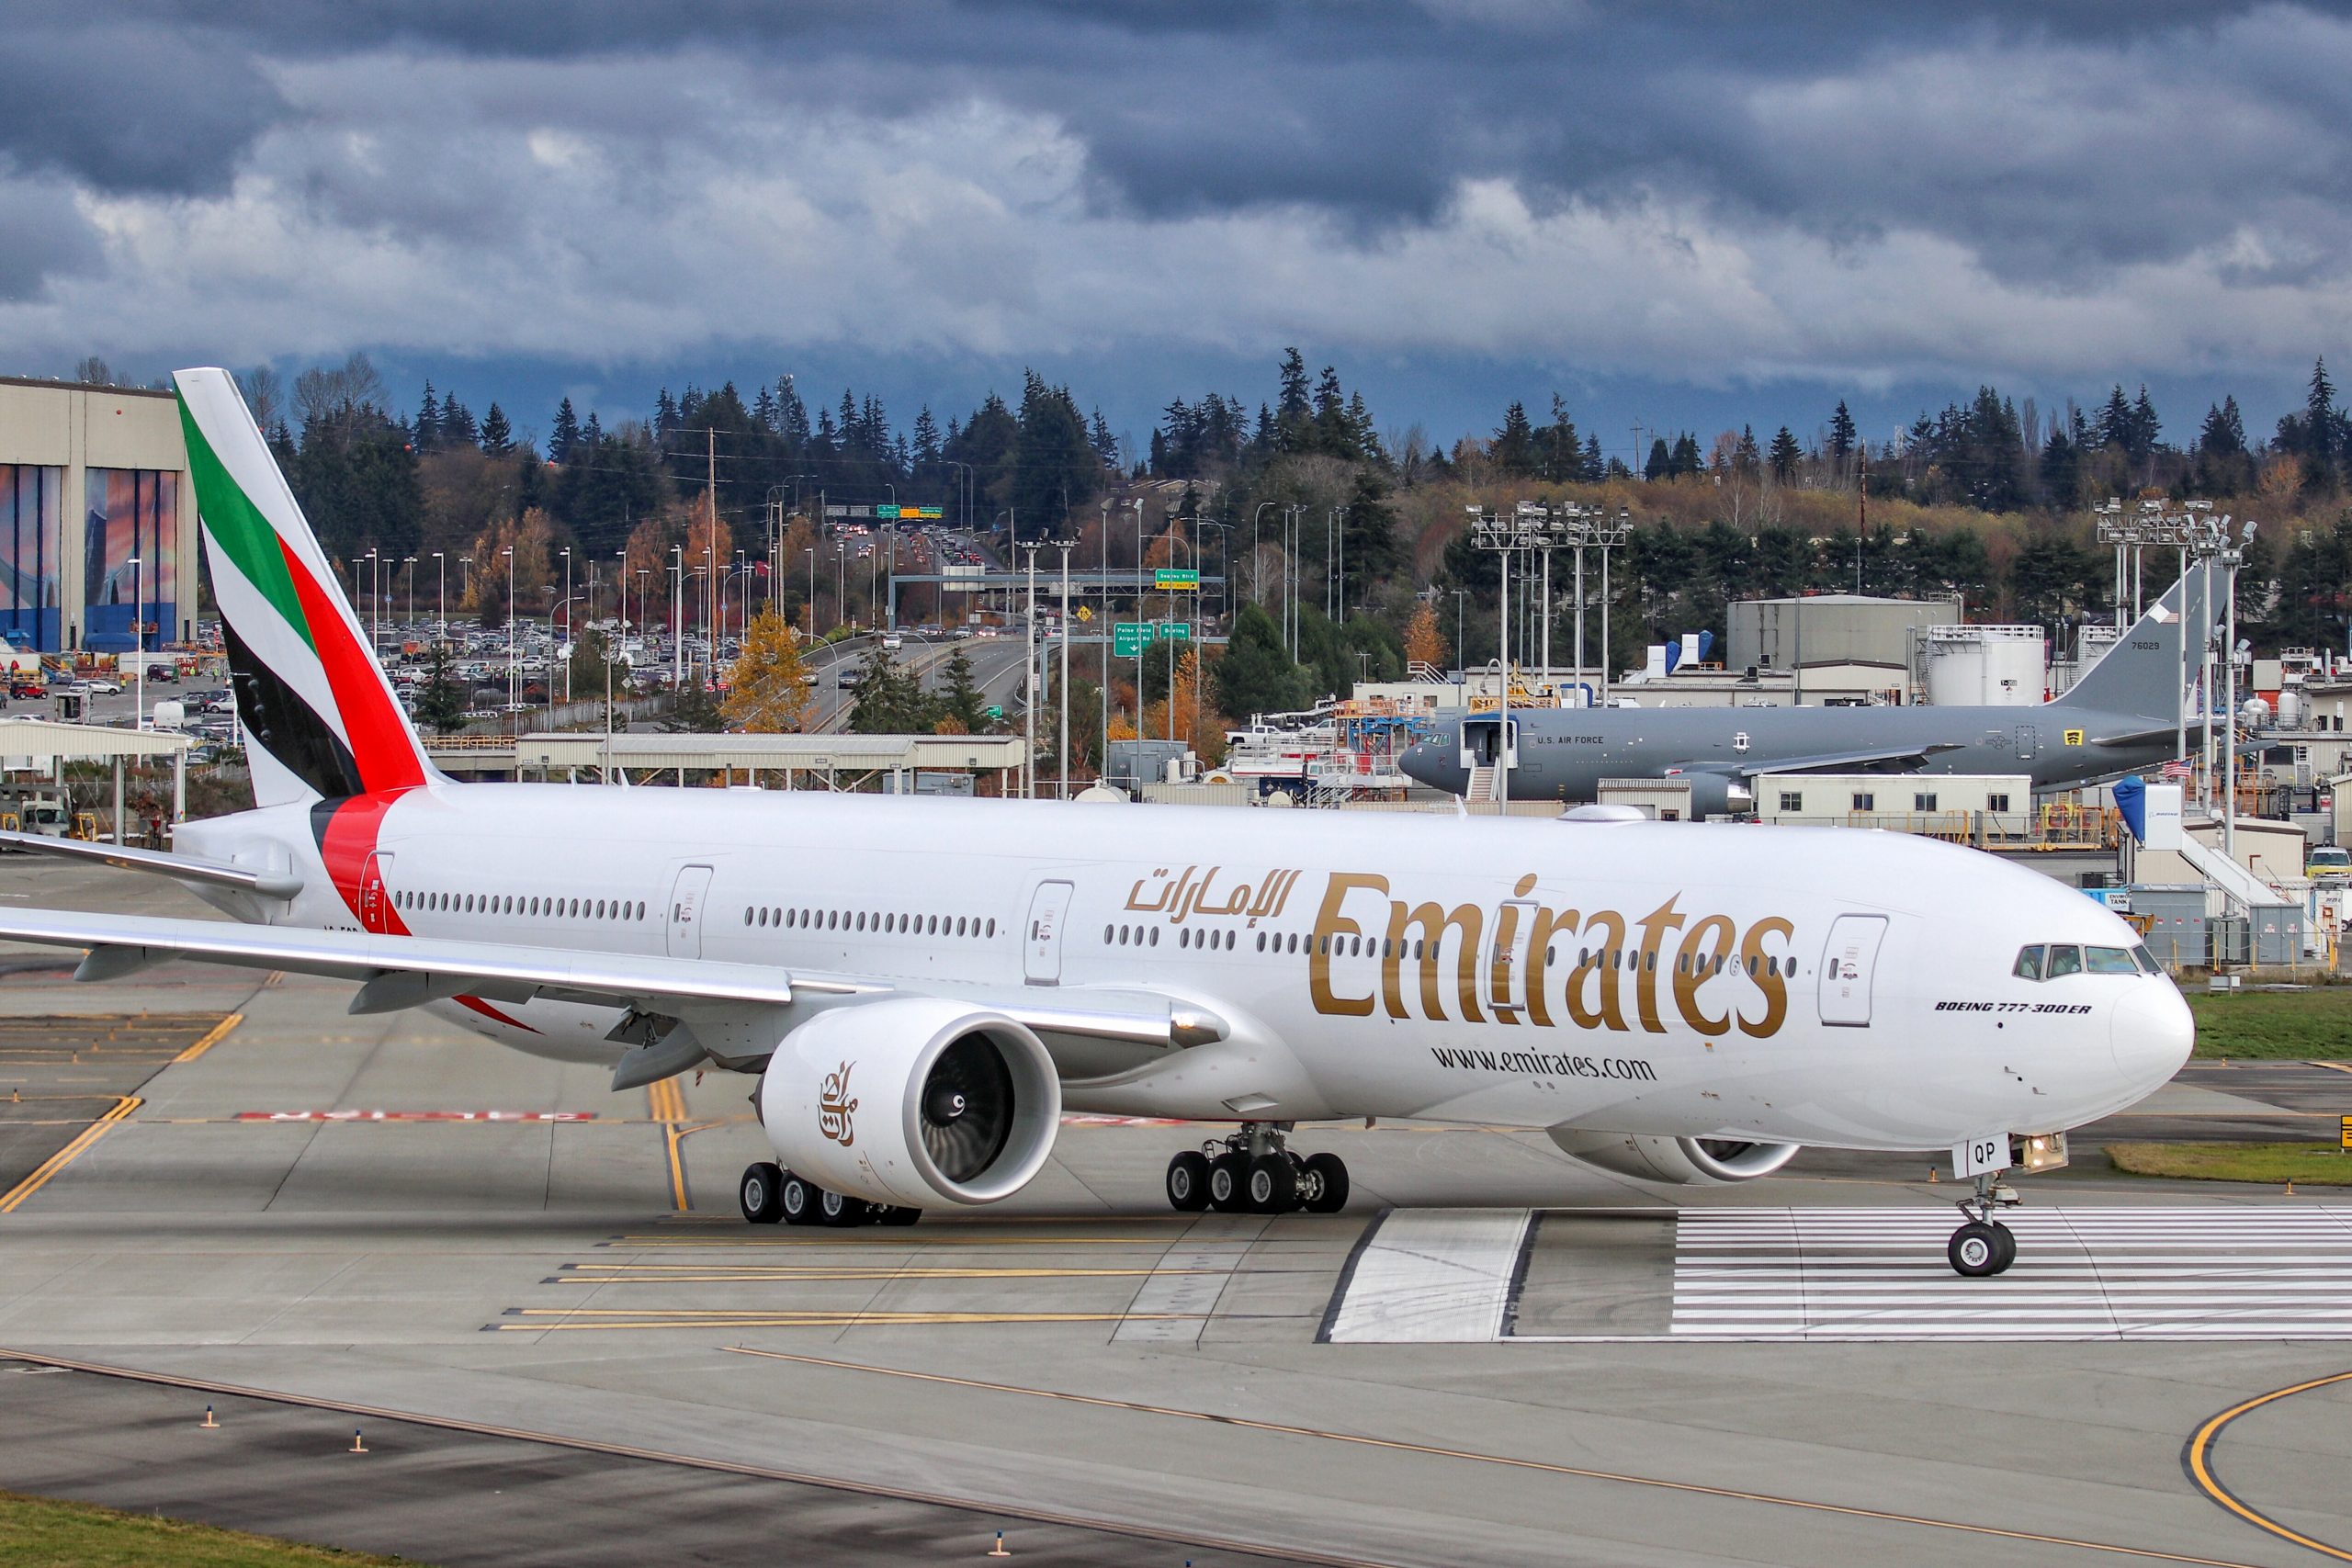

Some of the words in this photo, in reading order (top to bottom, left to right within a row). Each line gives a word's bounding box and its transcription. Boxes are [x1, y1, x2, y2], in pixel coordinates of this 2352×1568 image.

[2132, 641, 2159, 650] 76029
[1537, 736, 1555, 744] U.S.
[1558, 736, 1572, 744] AIR
[1575, 736, 1604, 744] FORCE
[1124, 865, 1303, 929] الإمارات
[1309, 872, 1795, 1039] Emirates
[1935, 1001, 1995, 1012] BOEING
[1430, 1046, 1659, 1081] www.emirates.com
[1974, 1142, 1995, 1165] QP
